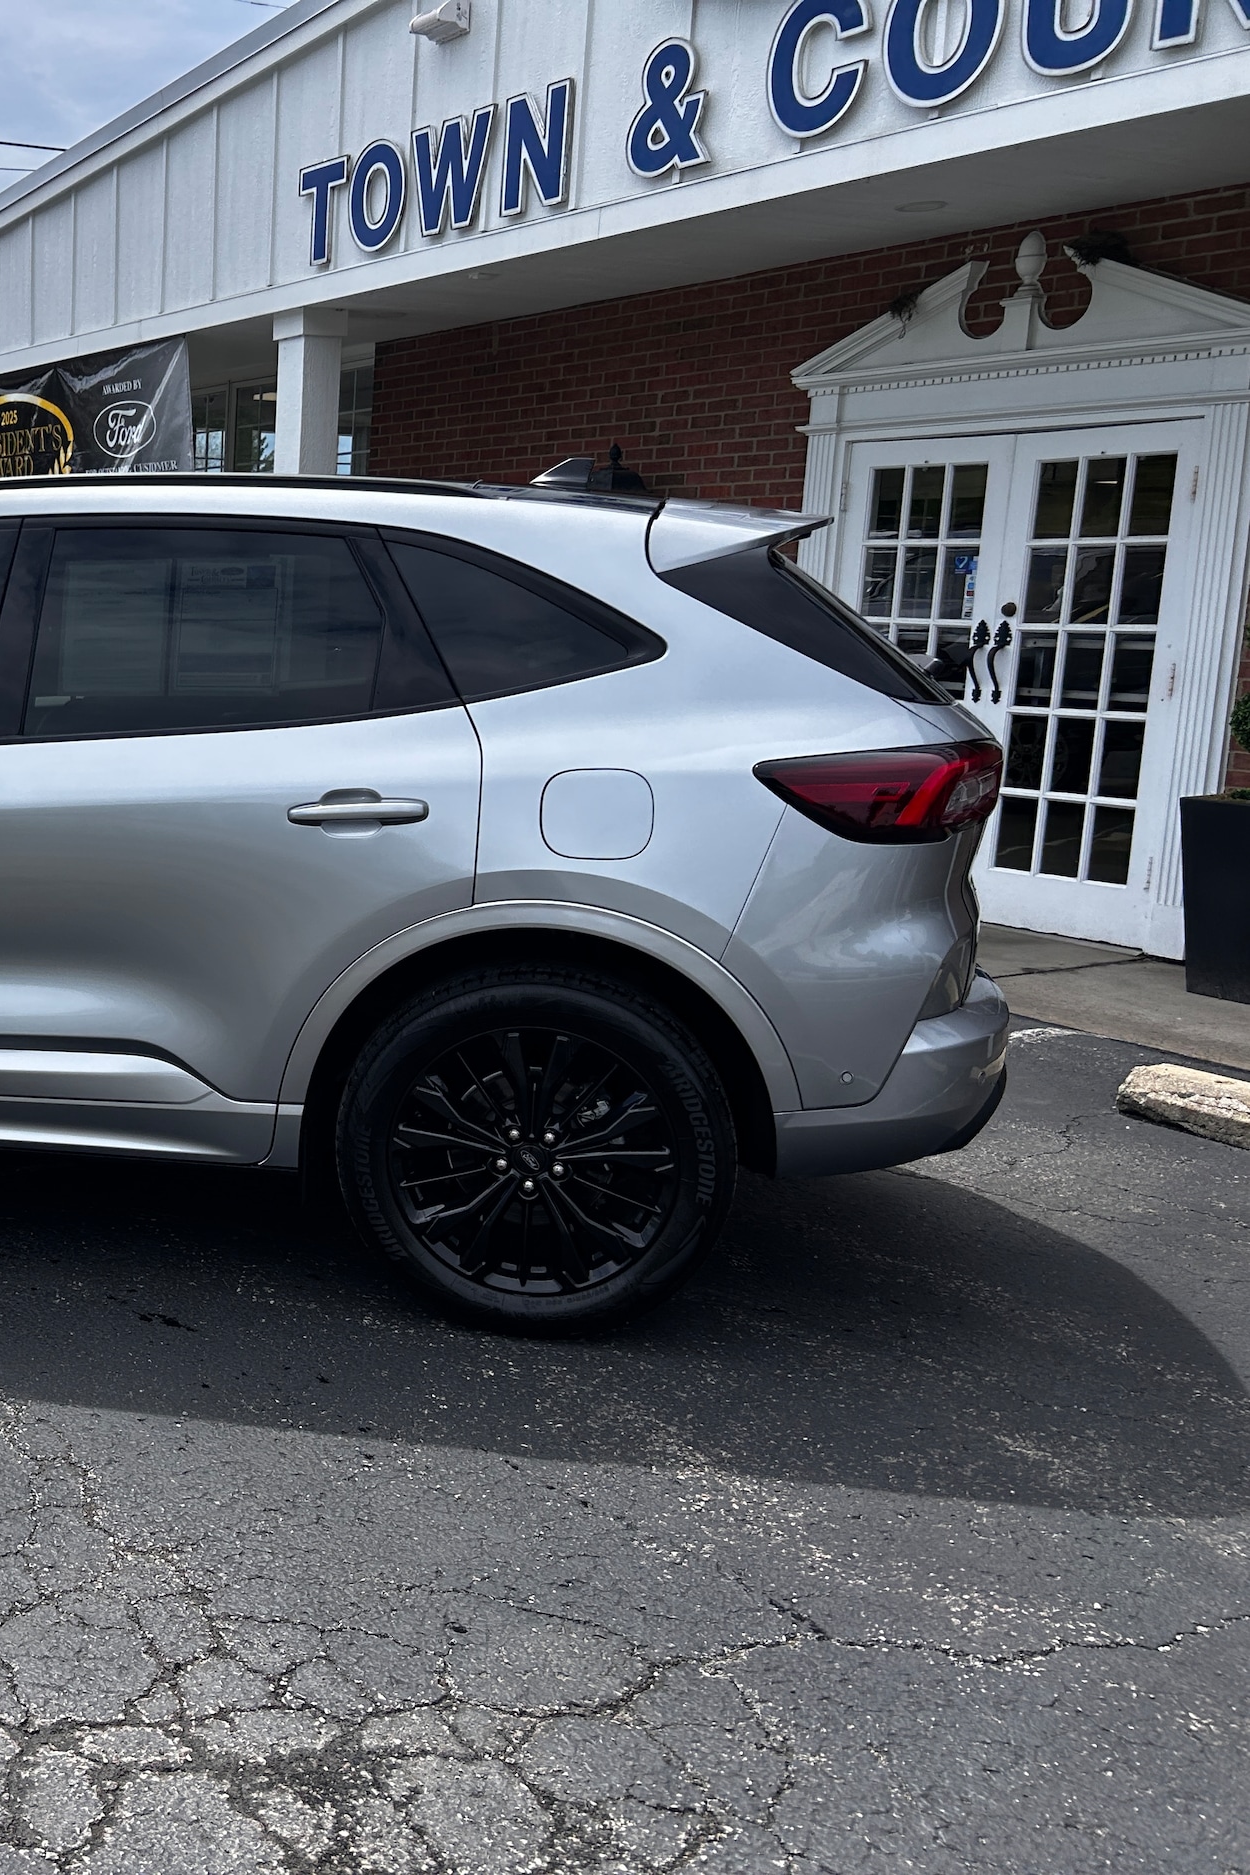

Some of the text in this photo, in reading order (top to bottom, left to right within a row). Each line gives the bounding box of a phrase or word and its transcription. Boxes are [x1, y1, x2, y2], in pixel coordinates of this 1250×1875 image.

[298, 0, 1250, 266] TOWN & COU
[102, 378, 142, 396] AWARDED BY
[0, 409, 18, 427] 2025
[105, 407, 144, 449] Ford
[657, 1061, 717, 1208] BRIDGESTONE
